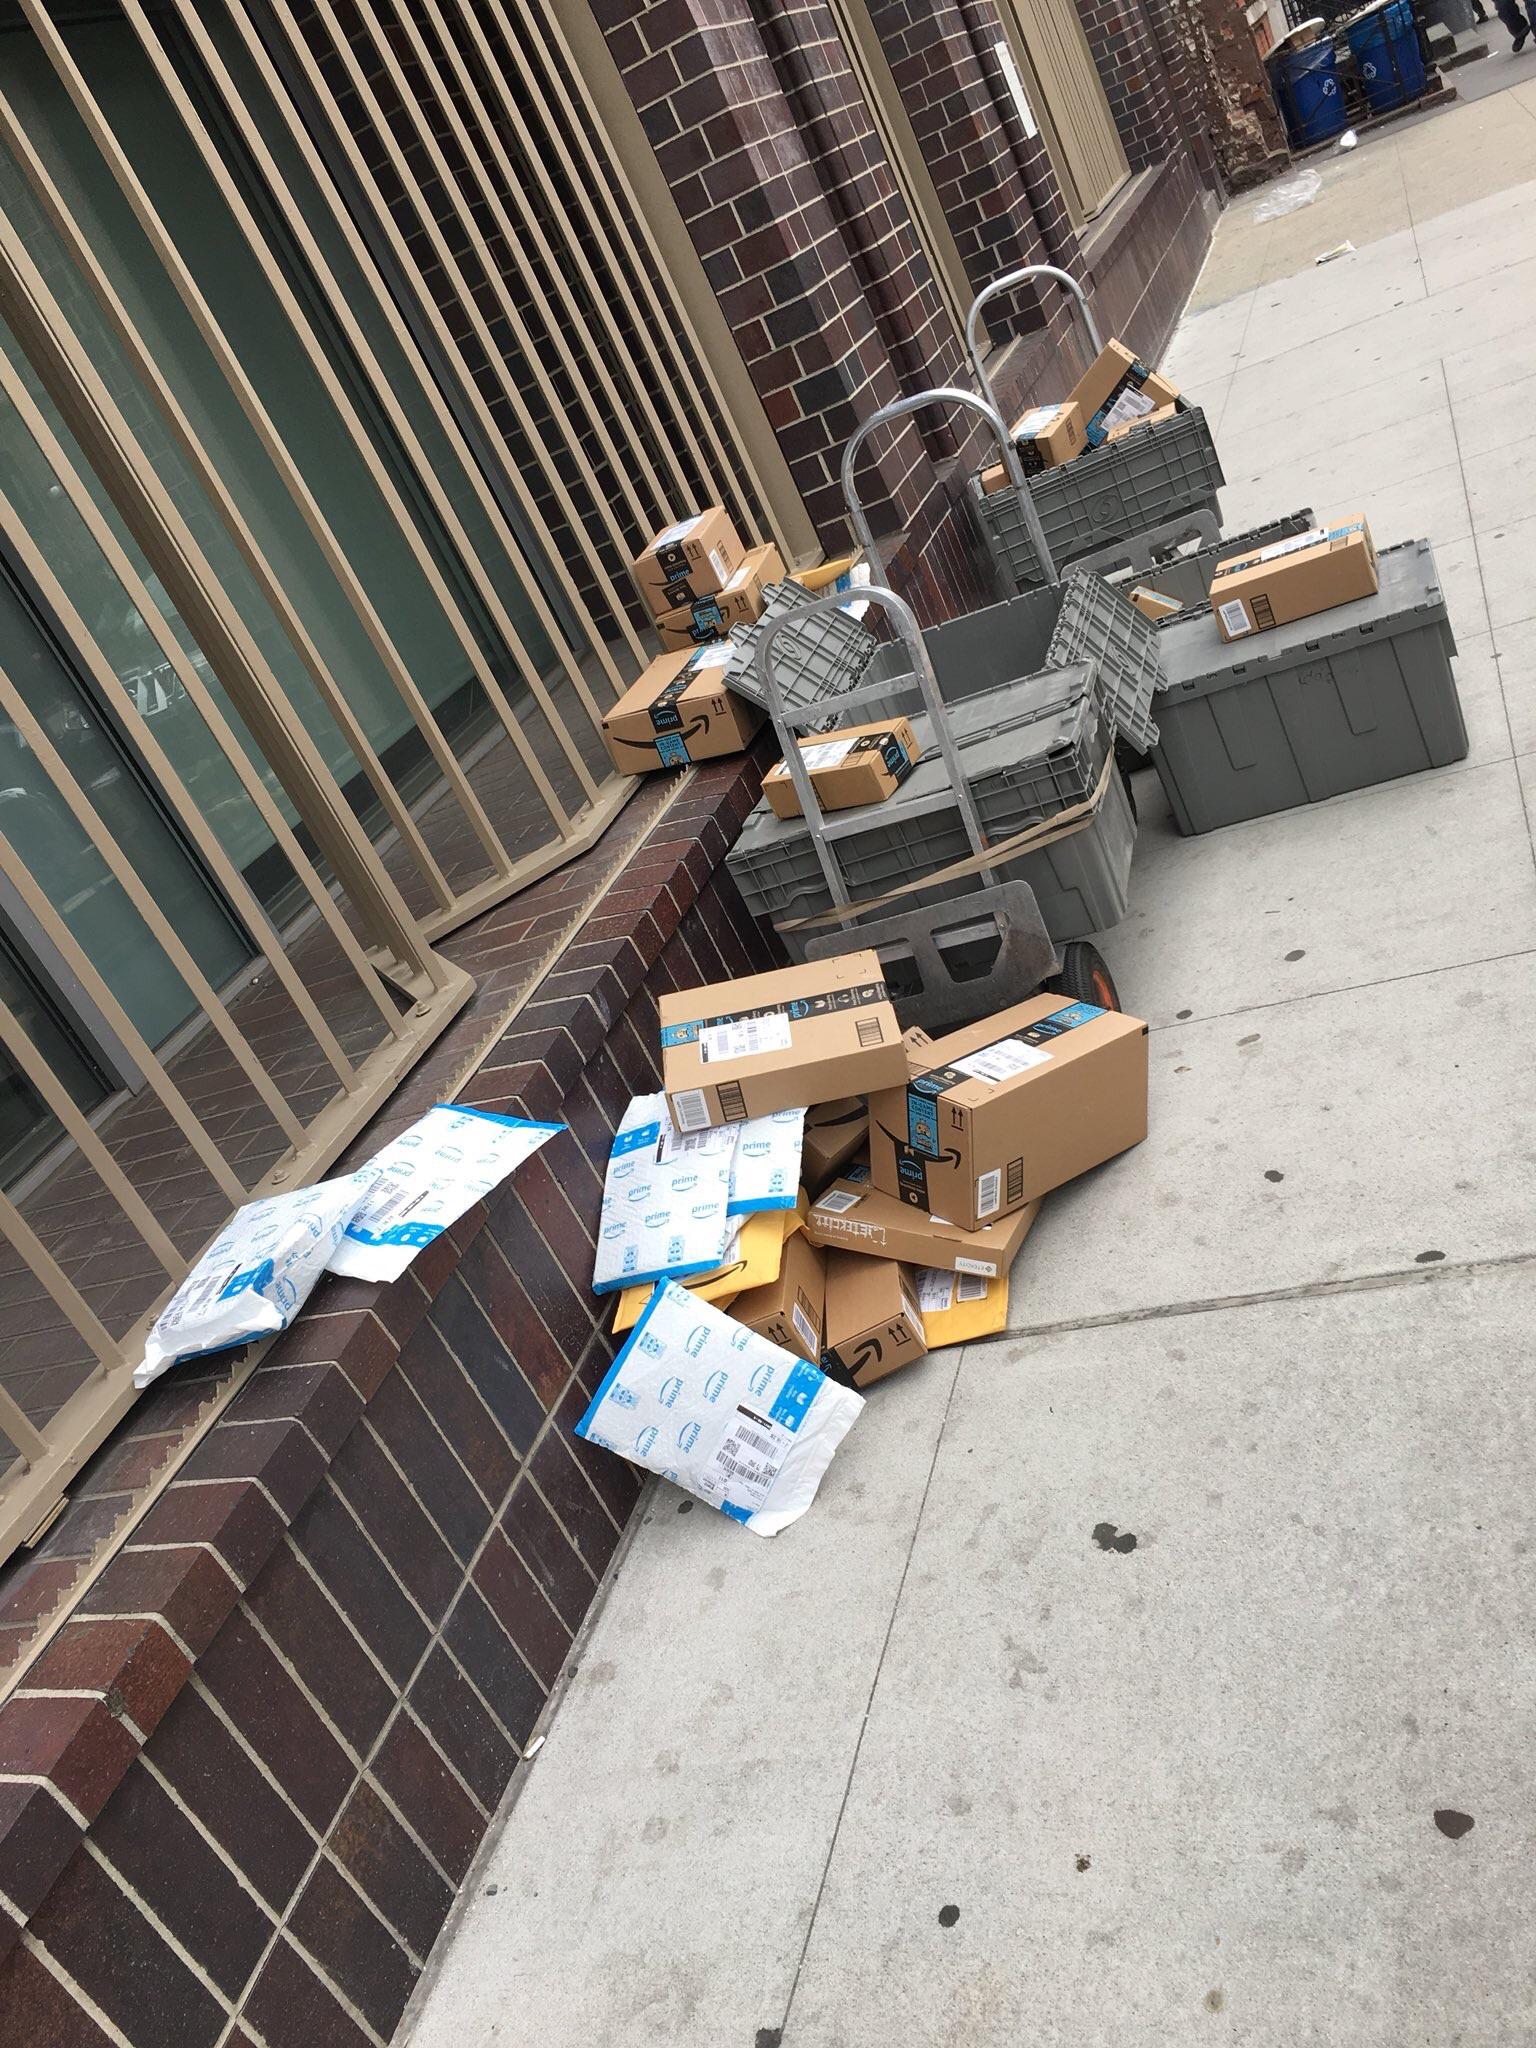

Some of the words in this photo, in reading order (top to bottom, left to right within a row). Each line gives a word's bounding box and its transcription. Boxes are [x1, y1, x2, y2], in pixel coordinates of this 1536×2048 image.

[656, 715, 679, 726] prime
[916, 1079, 943, 1091] prime
[743, 1141, 771, 1151] prime
[613, 1161, 635, 1174] prime
[900, 1166, 923, 1180] prime
[671, 1174, 698, 1186] prime
[628, 1184, 652, 1198] prime
[691, 1202, 719, 1214] prime
[644, 1210, 671, 1223] prime
[603, 1221, 627, 1234] prime
[275, 1282, 293, 1311] prime
[690, 1326, 711, 1358] prime
[708, 1370, 729, 1403] prime
[756, 1364, 775, 1397] prime
[665, 1377, 684, 1408] prime
[640, 1426, 659, 1457] prime
[683, 1422, 702, 1454] prime
